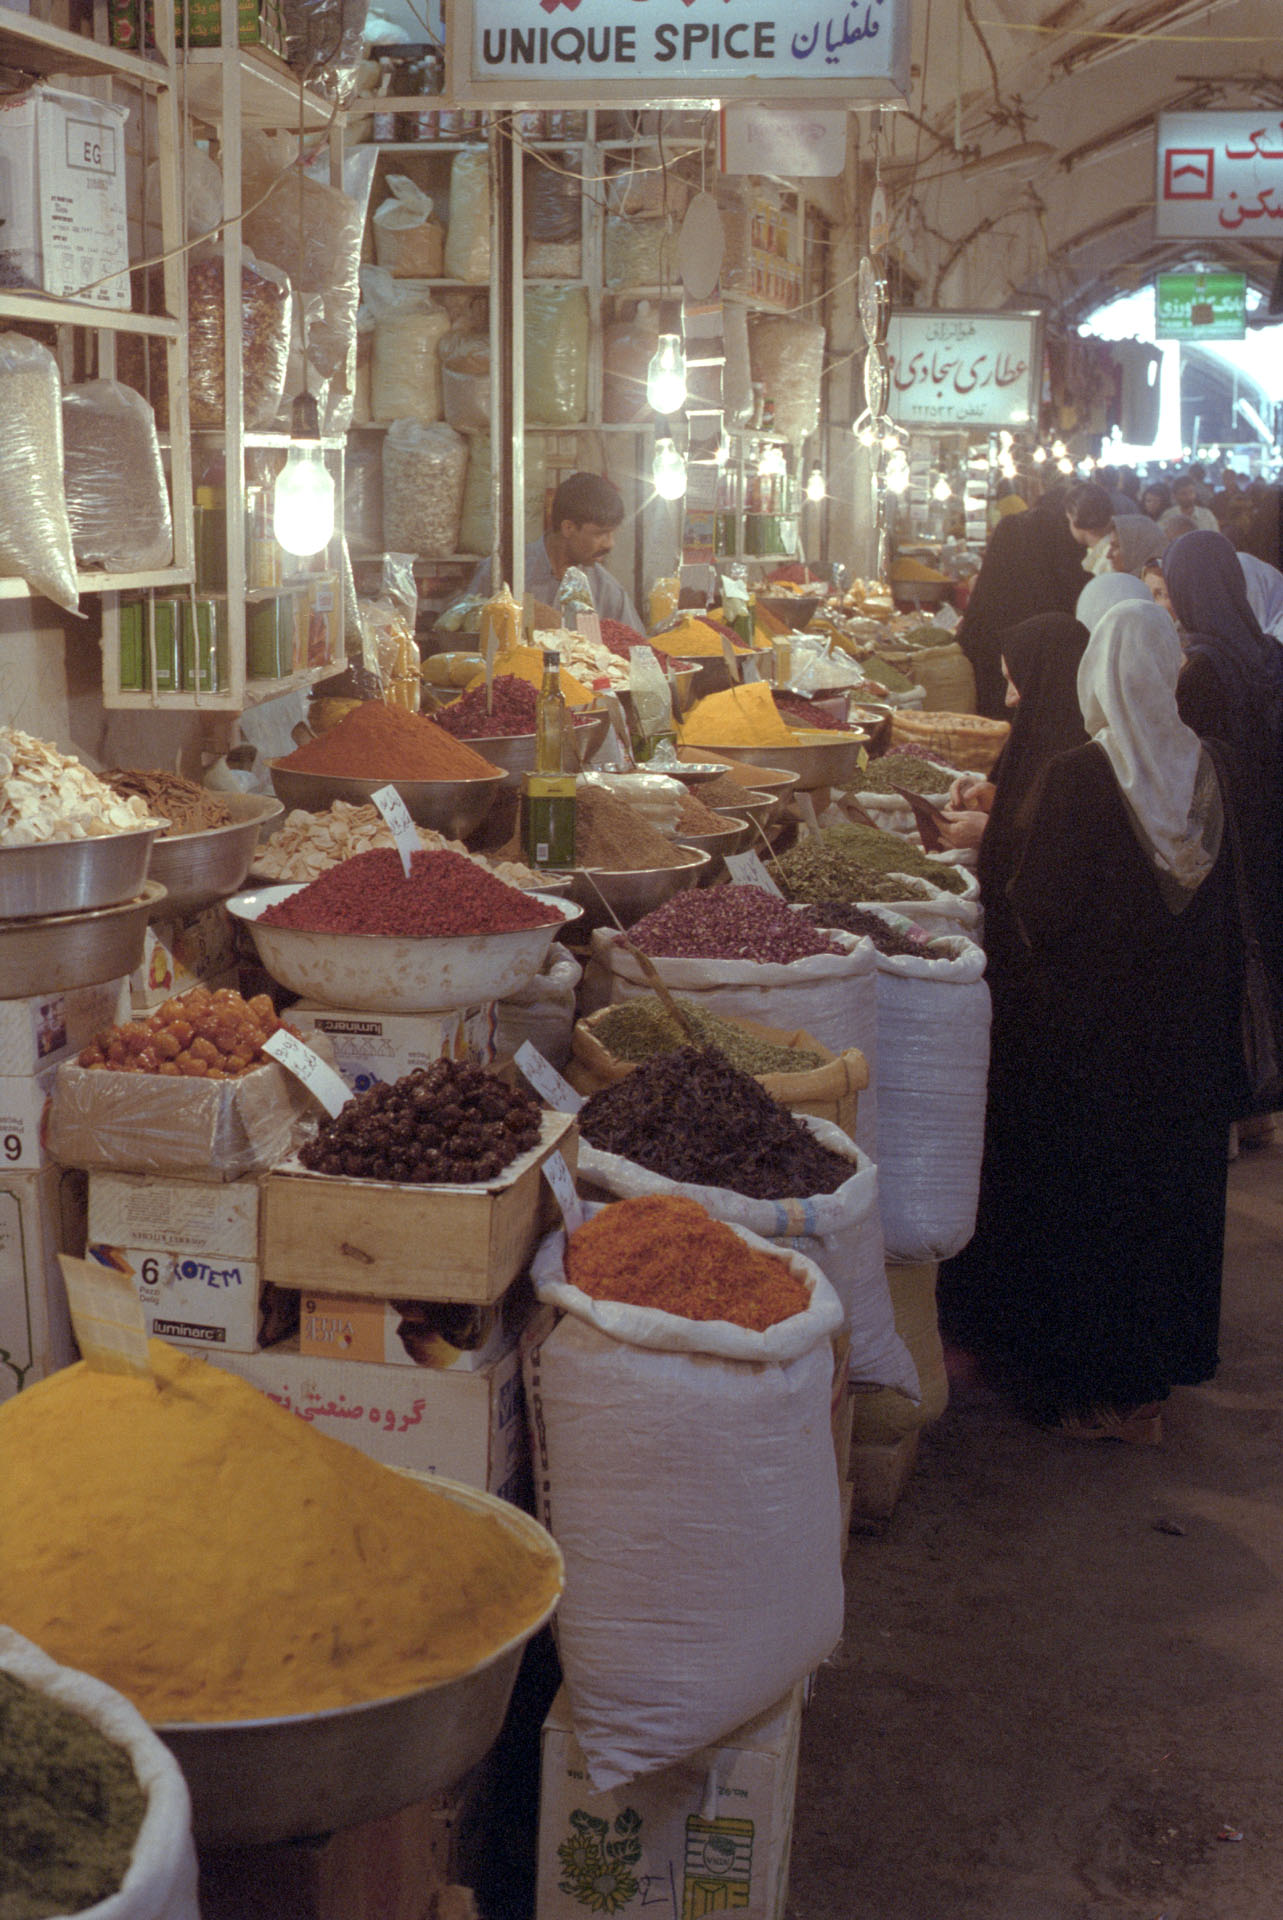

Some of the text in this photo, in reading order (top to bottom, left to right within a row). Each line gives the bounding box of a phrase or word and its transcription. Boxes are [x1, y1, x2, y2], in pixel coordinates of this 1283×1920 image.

[482, 21, 776, 65] UNIQUE SPICE
[954, 351, 1028, 394] عطاری
[325, 1019, 382, 1035] luminarc
[141, 1258, 160, 1285] 6
[154, 1320, 215, 1340] luminarc
[294, 1393, 365, 1422] صنعتی
[368, 1397, 427, 1432] گروه
